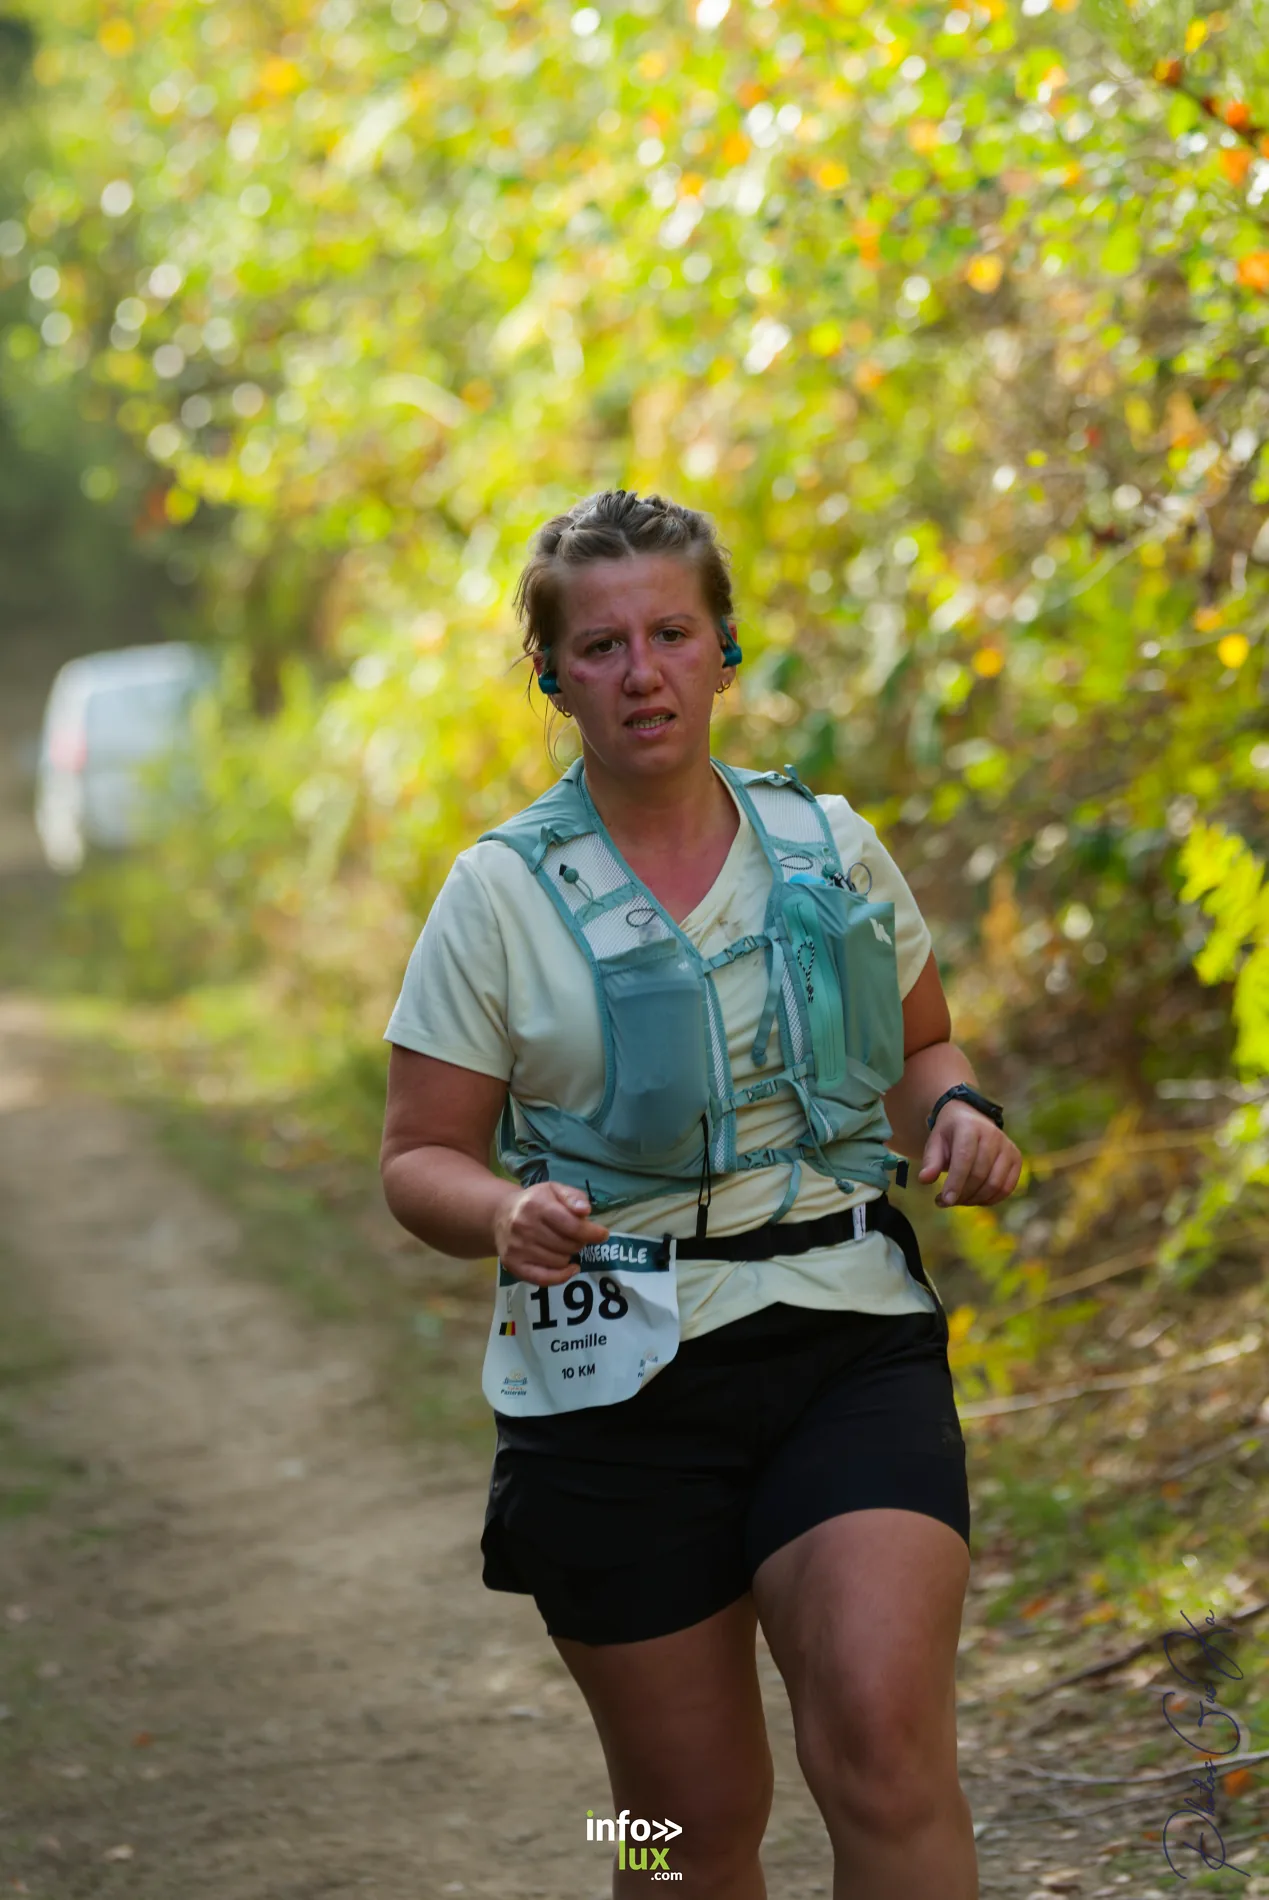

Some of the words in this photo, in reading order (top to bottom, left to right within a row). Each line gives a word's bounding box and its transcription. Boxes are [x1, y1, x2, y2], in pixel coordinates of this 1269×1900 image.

[530, 1277, 629, 1330] 198
[550, 1333, 607, 1353] Camille
[562, 1367, 574, 1379] 10
[579, 1364, 596, 1376] KM
